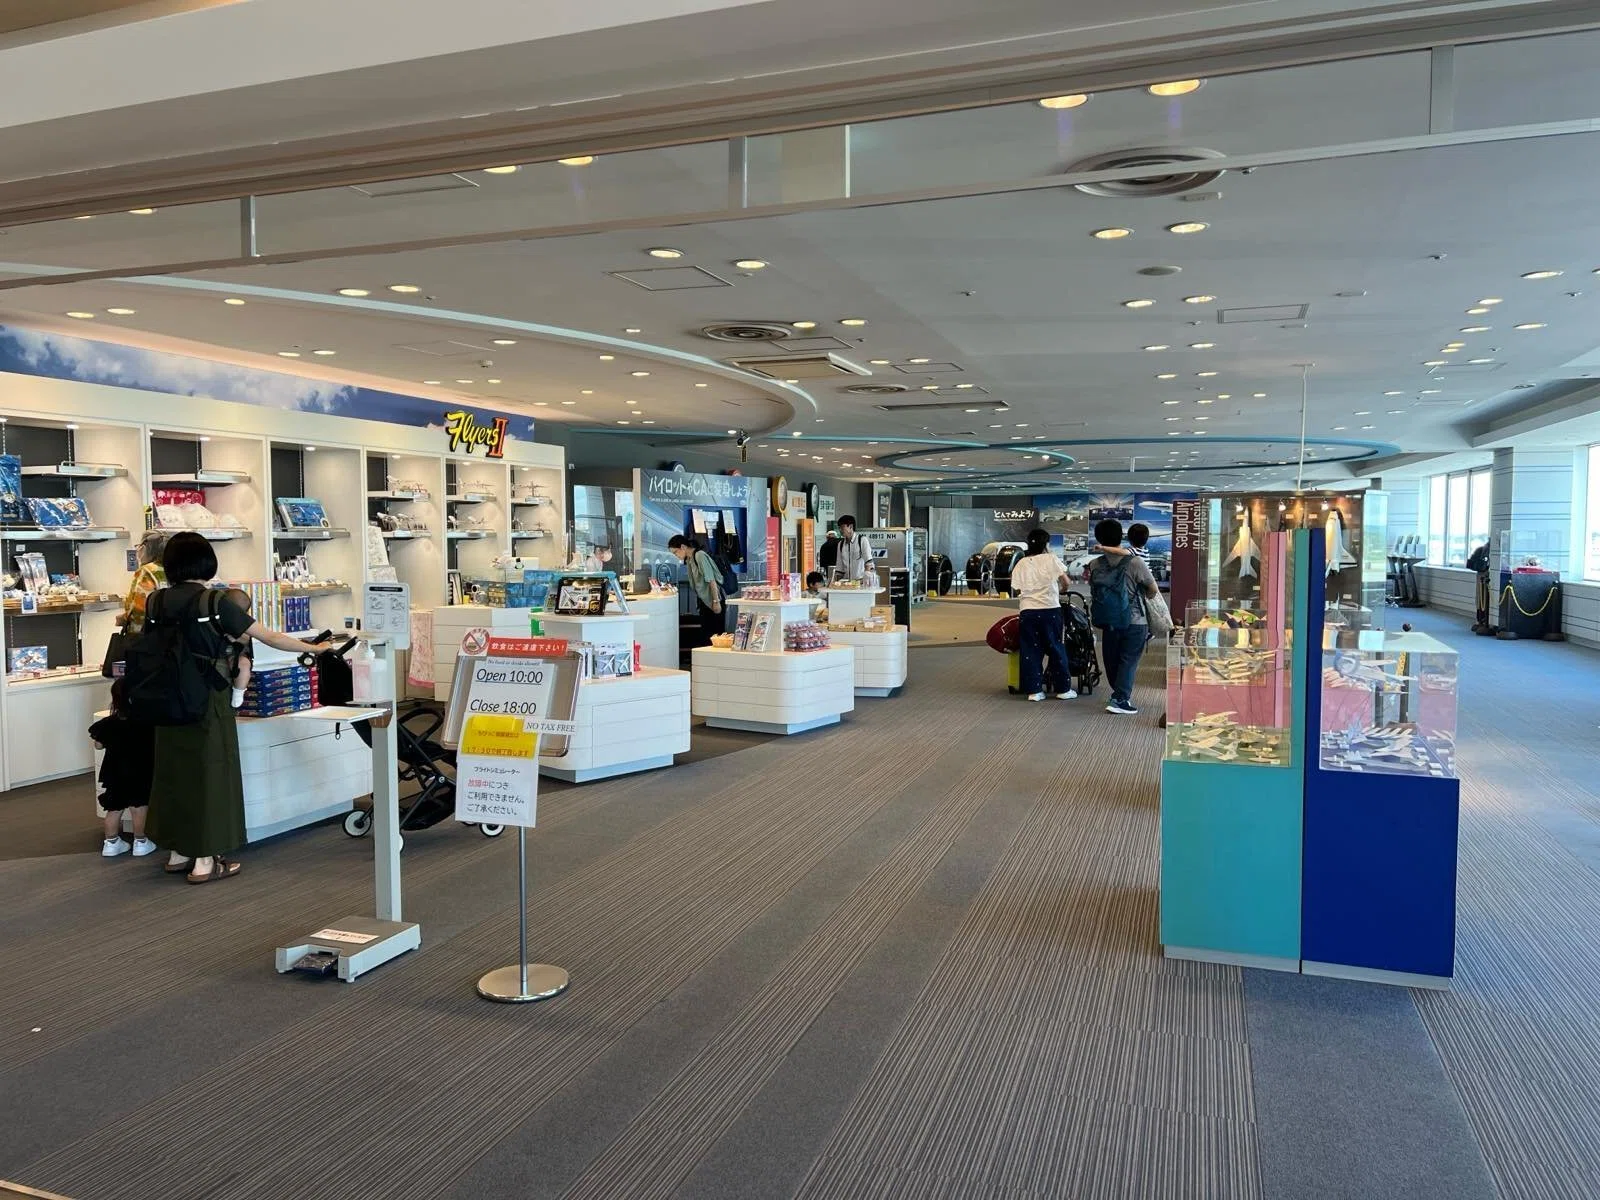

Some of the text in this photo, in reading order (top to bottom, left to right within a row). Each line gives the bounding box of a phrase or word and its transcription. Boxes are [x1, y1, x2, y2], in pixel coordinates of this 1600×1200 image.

[445, 411, 499, 453] Flyers
[1172, 501, 1194, 548] Airplanes
[476, 668, 543, 684] Open 10:00
[470, 699, 537, 715] Close 18:00
[526, 722, 575, 732] NO TAX FREE
[467, 791, 525, 804] ご利用できません。
[466, 803, 517, 816] ご了承ください。
